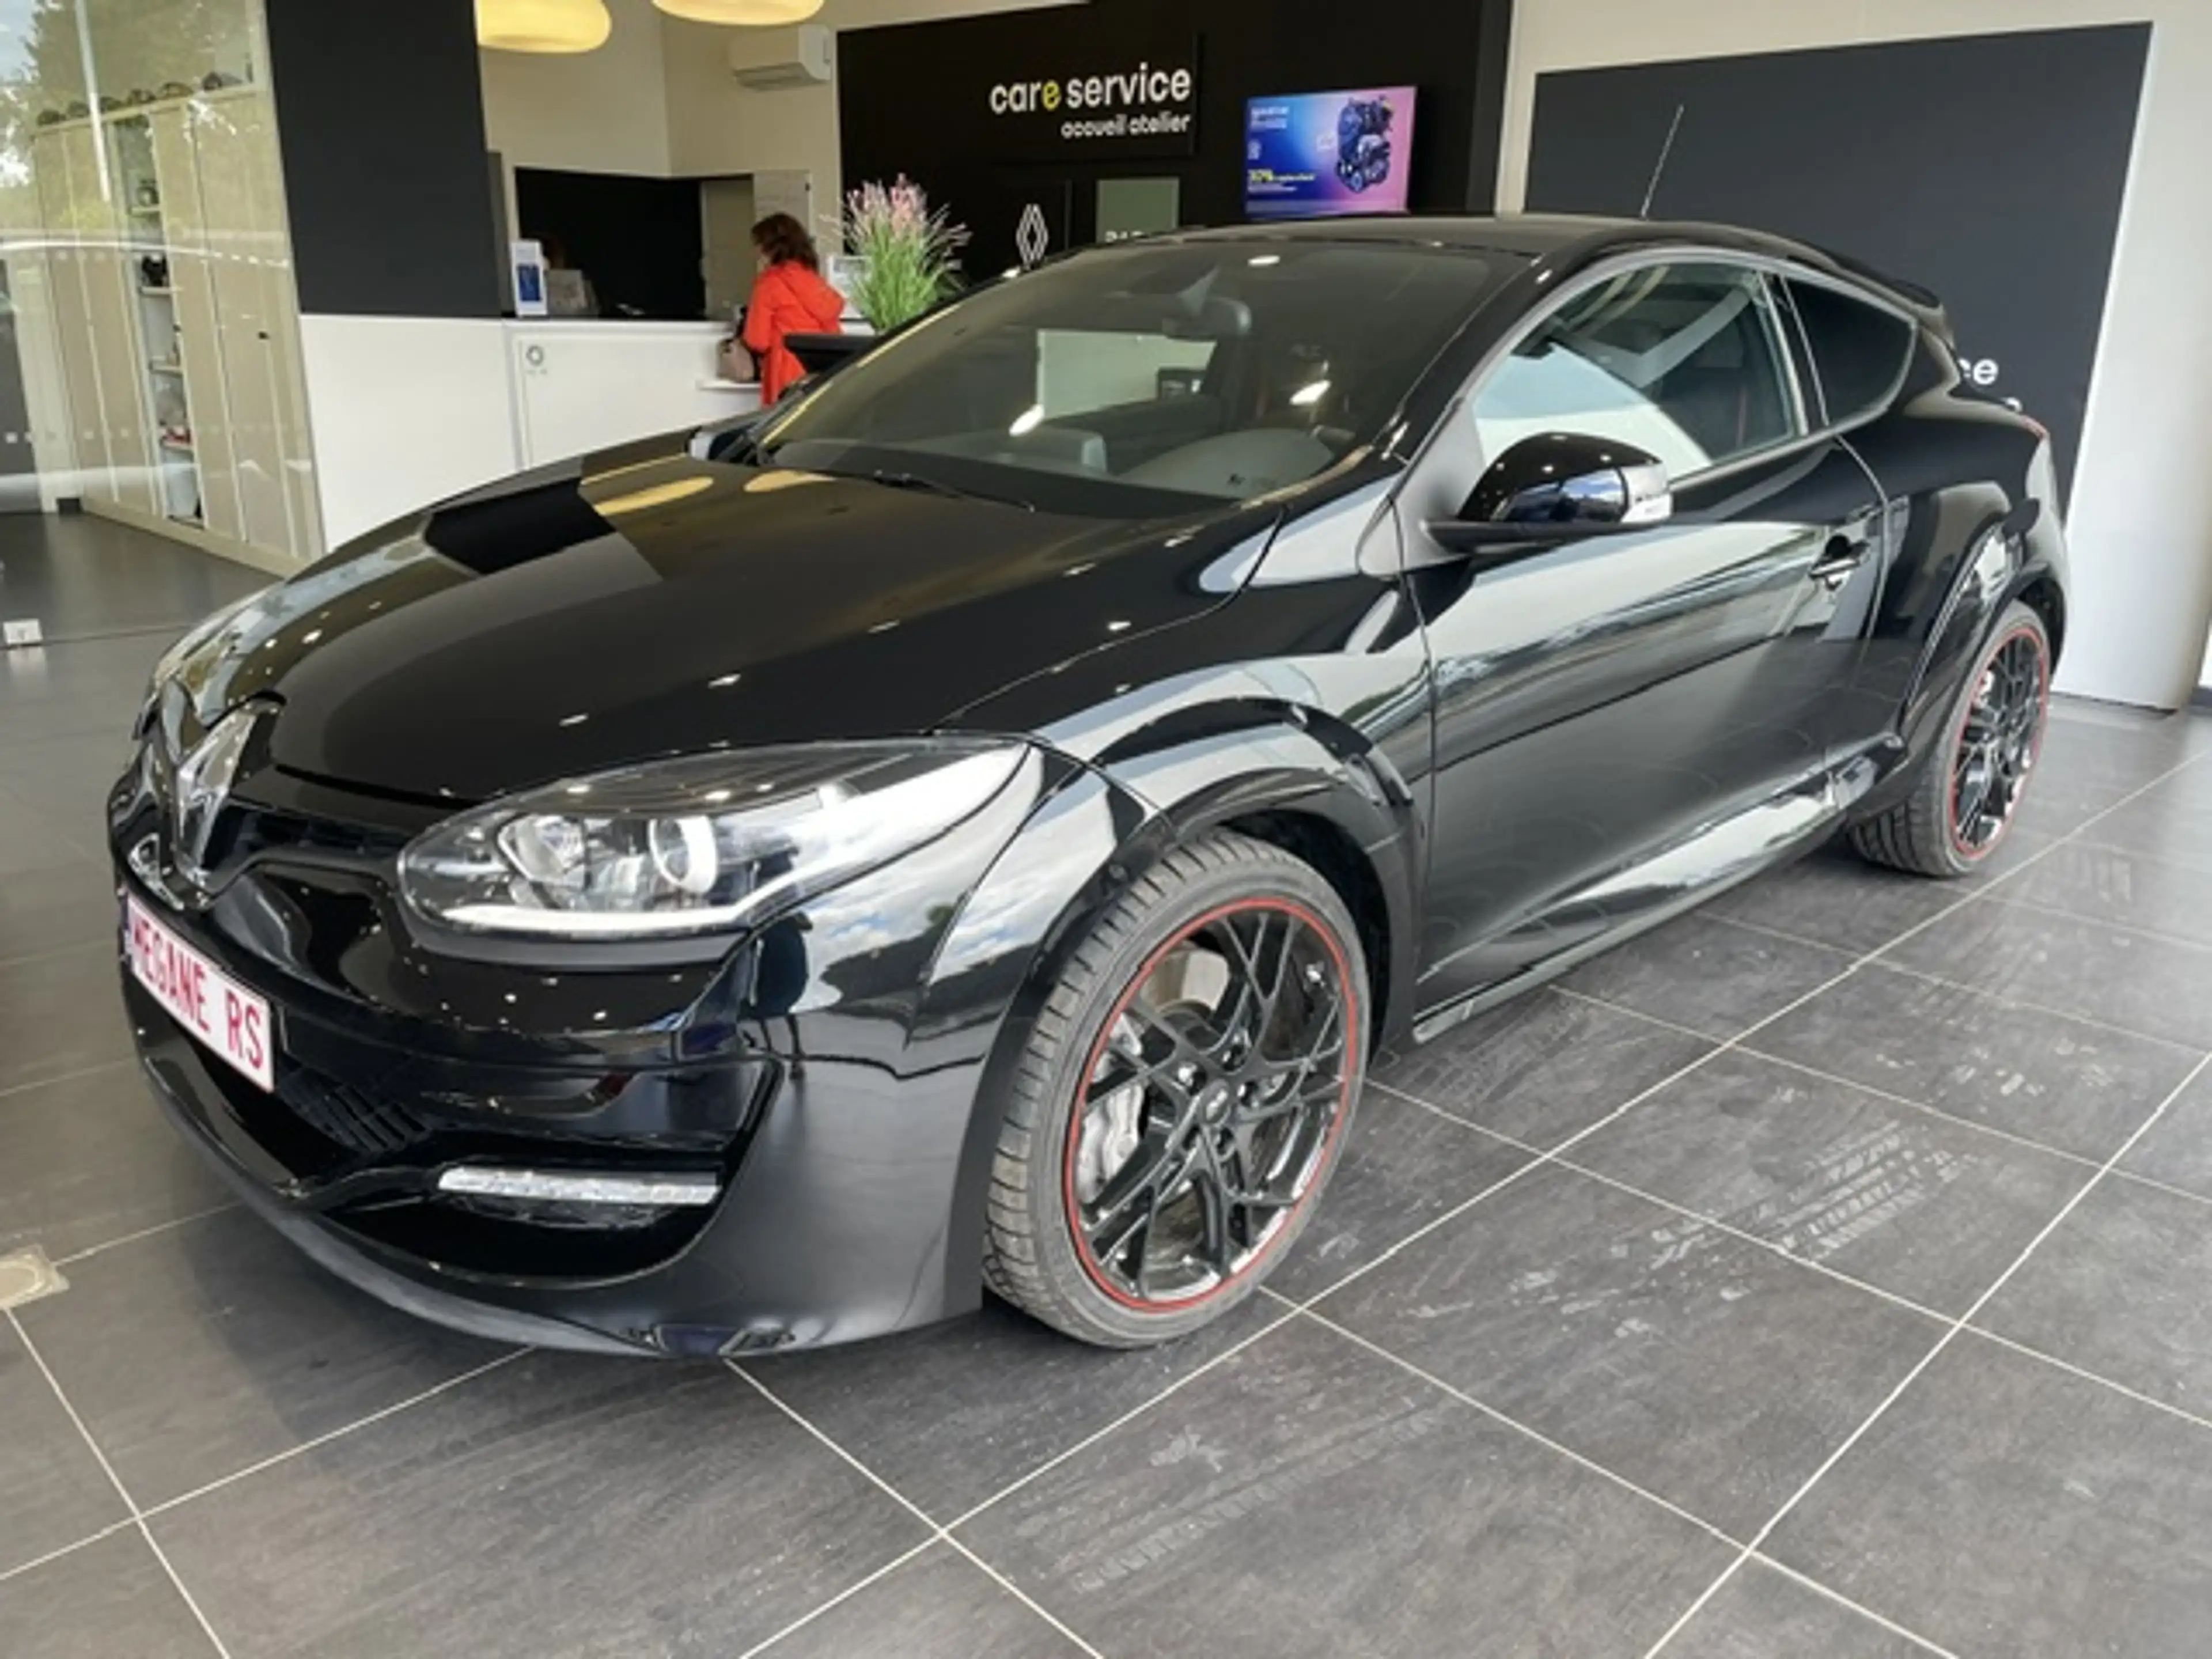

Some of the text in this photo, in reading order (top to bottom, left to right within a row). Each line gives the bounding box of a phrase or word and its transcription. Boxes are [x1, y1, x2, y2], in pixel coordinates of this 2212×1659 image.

[990, 62, 1191, 113] care service
[1061, 110, 1191, 138] accueil atelier
[134, 919, 263, 1070] MEGANE RS
